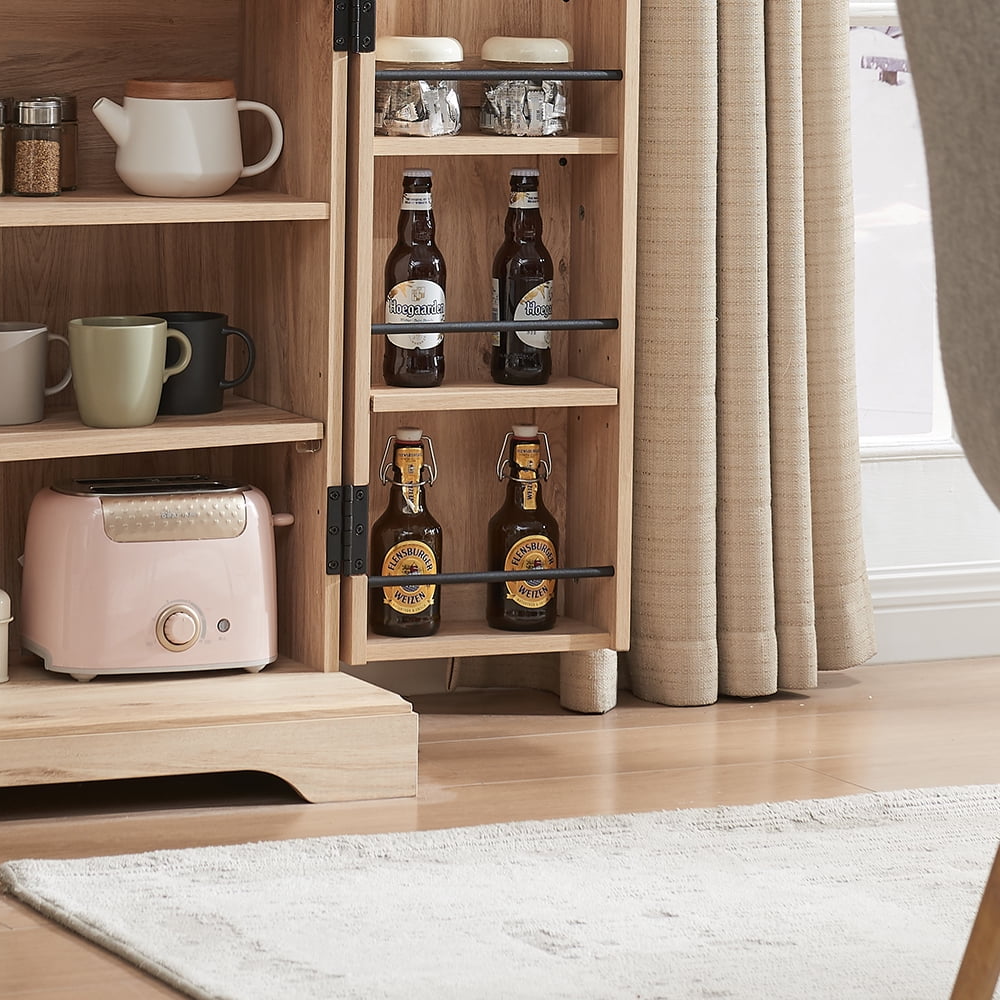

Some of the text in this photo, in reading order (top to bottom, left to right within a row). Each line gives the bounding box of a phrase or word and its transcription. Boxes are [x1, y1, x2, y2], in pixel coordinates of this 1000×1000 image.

[388, 298, 445, 319] Hoegaarden
[387, 547, 434, 572] FLENSBURGER
[511, 541, 555, 567] FLENSBURGER
[394, 590, 426, 605] WEIZEN
[518, 585, 549, 600] WEIZEN
